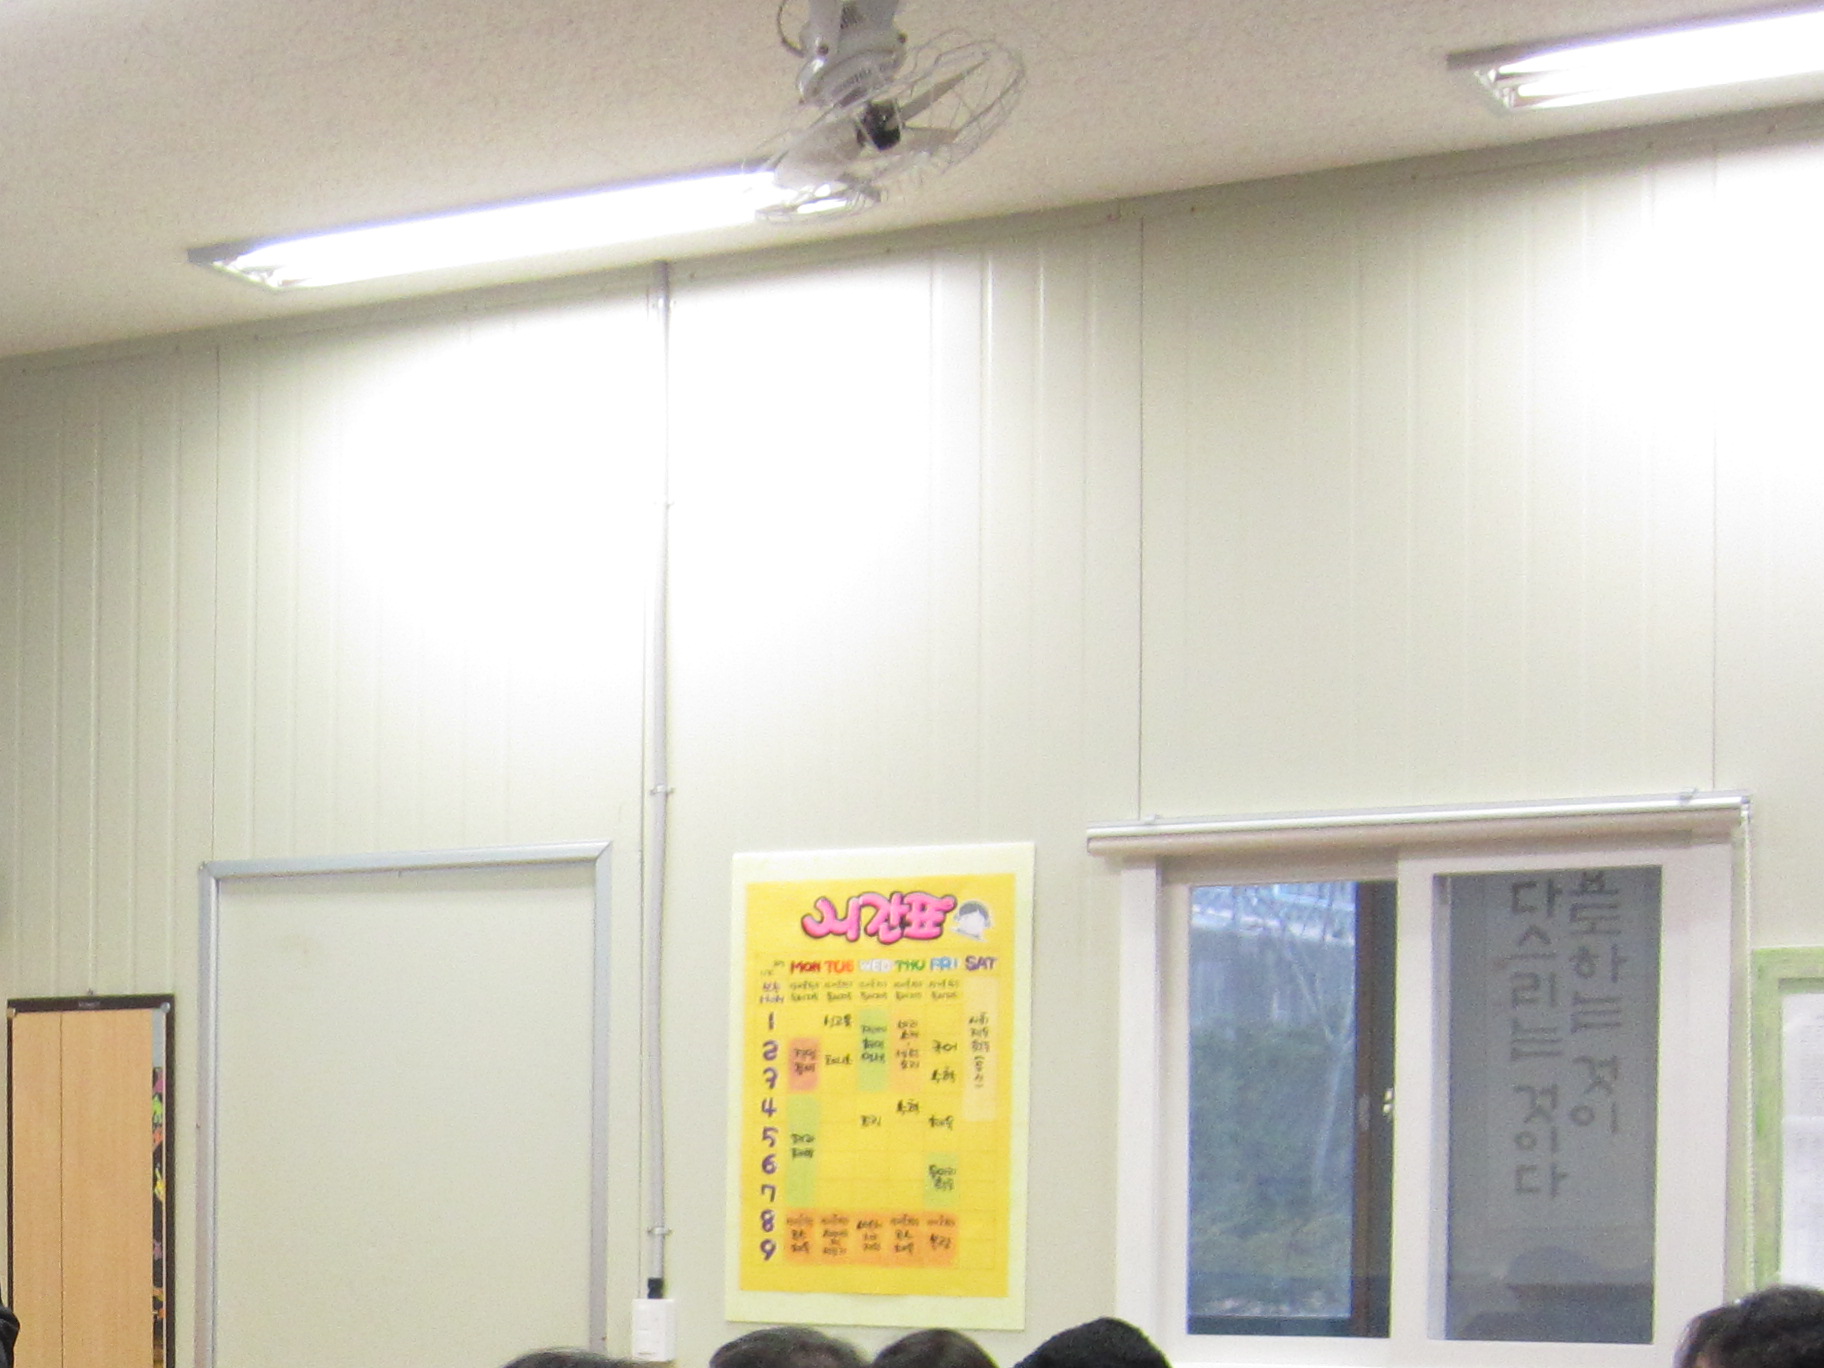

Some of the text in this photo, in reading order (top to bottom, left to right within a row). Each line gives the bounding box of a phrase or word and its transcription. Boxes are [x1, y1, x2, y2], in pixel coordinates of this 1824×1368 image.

[801, 891, 957, 945] 시간표
[790, 960, 821, 974] MON
[824, 959, 855, 973] TUE
[894, 958, 926, 972] THU
[964, 954, 998, 972] SAT
[1509, 878, 1564, 1062] 다스리는
[761, 1097, 777, 1118] 4
[761, 1126, 779, 1148] 5
[761, 1153, 777, 1175] 6
[761, 1183, 776, 1203] 7
[760, 1208, 775, 1233] 8
[759, 1237, 776, 1262] 9
